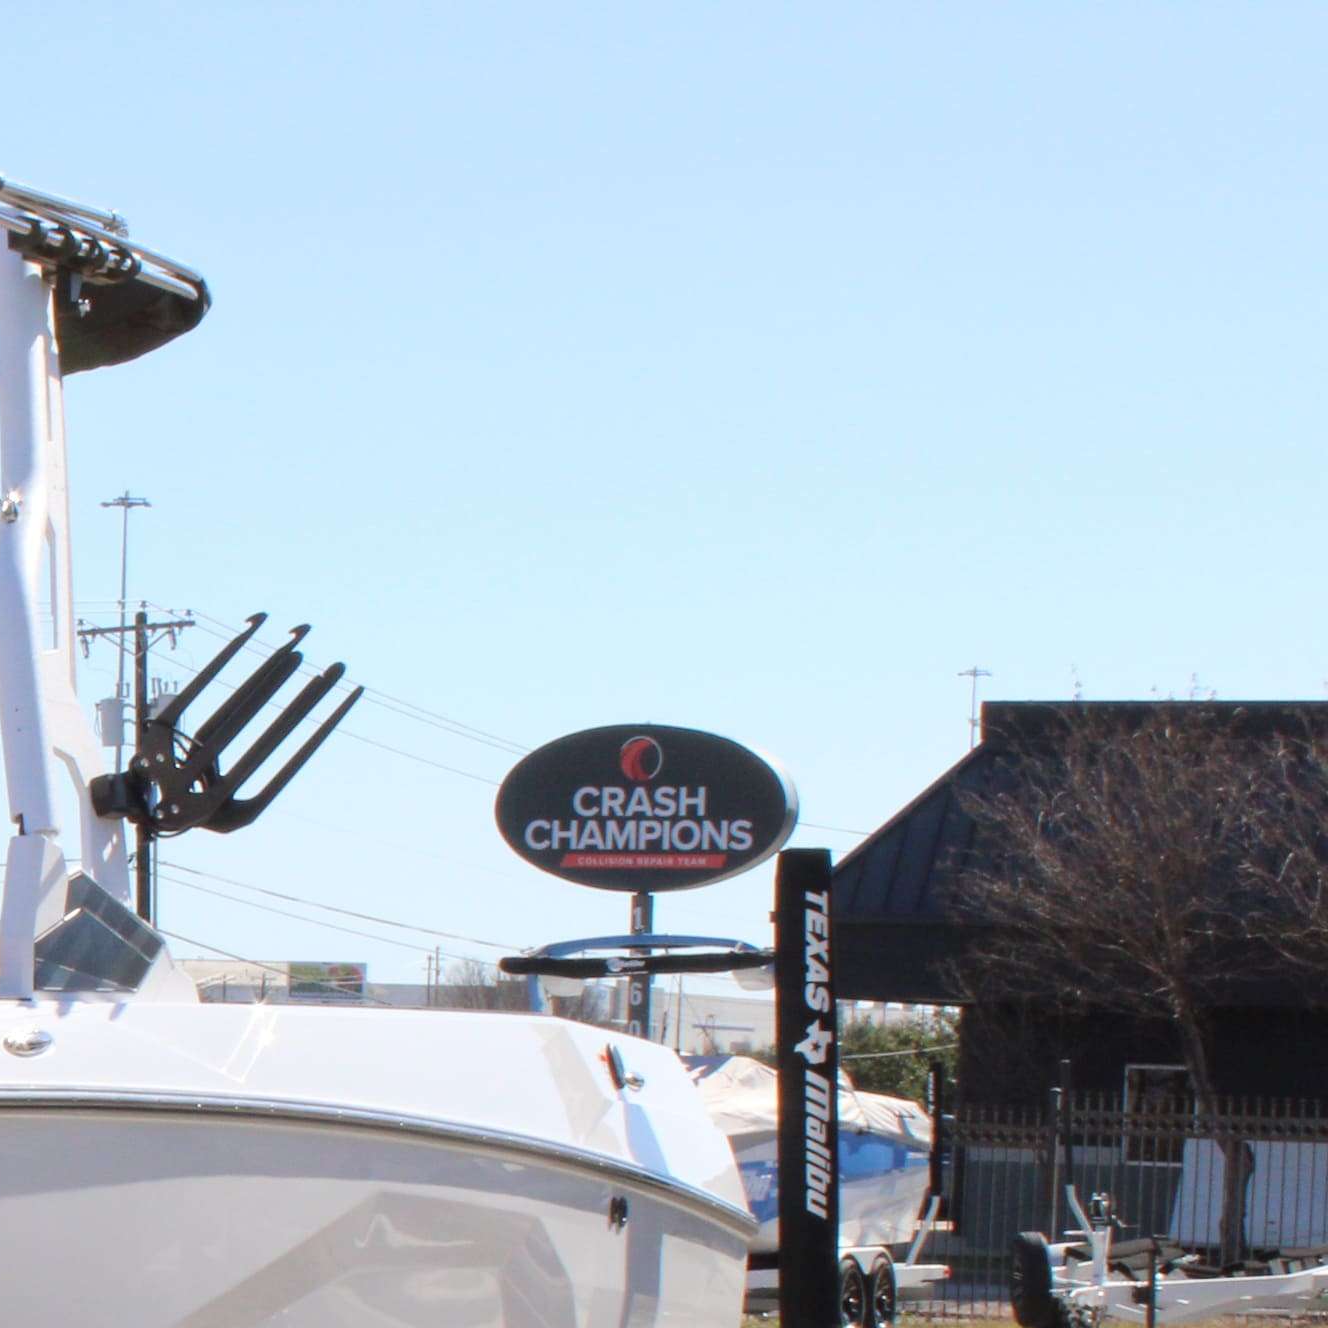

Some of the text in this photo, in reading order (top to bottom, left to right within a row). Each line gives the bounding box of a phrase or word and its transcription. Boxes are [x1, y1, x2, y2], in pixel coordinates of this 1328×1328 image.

[572, 785, 707, 817] CRASH
[523, 818, 754, 851] CHAMPIONS
[577, 857, 707, 867] COLLISION REPAIR TEAM
[805, 889, 830, 1013] TEXAS
